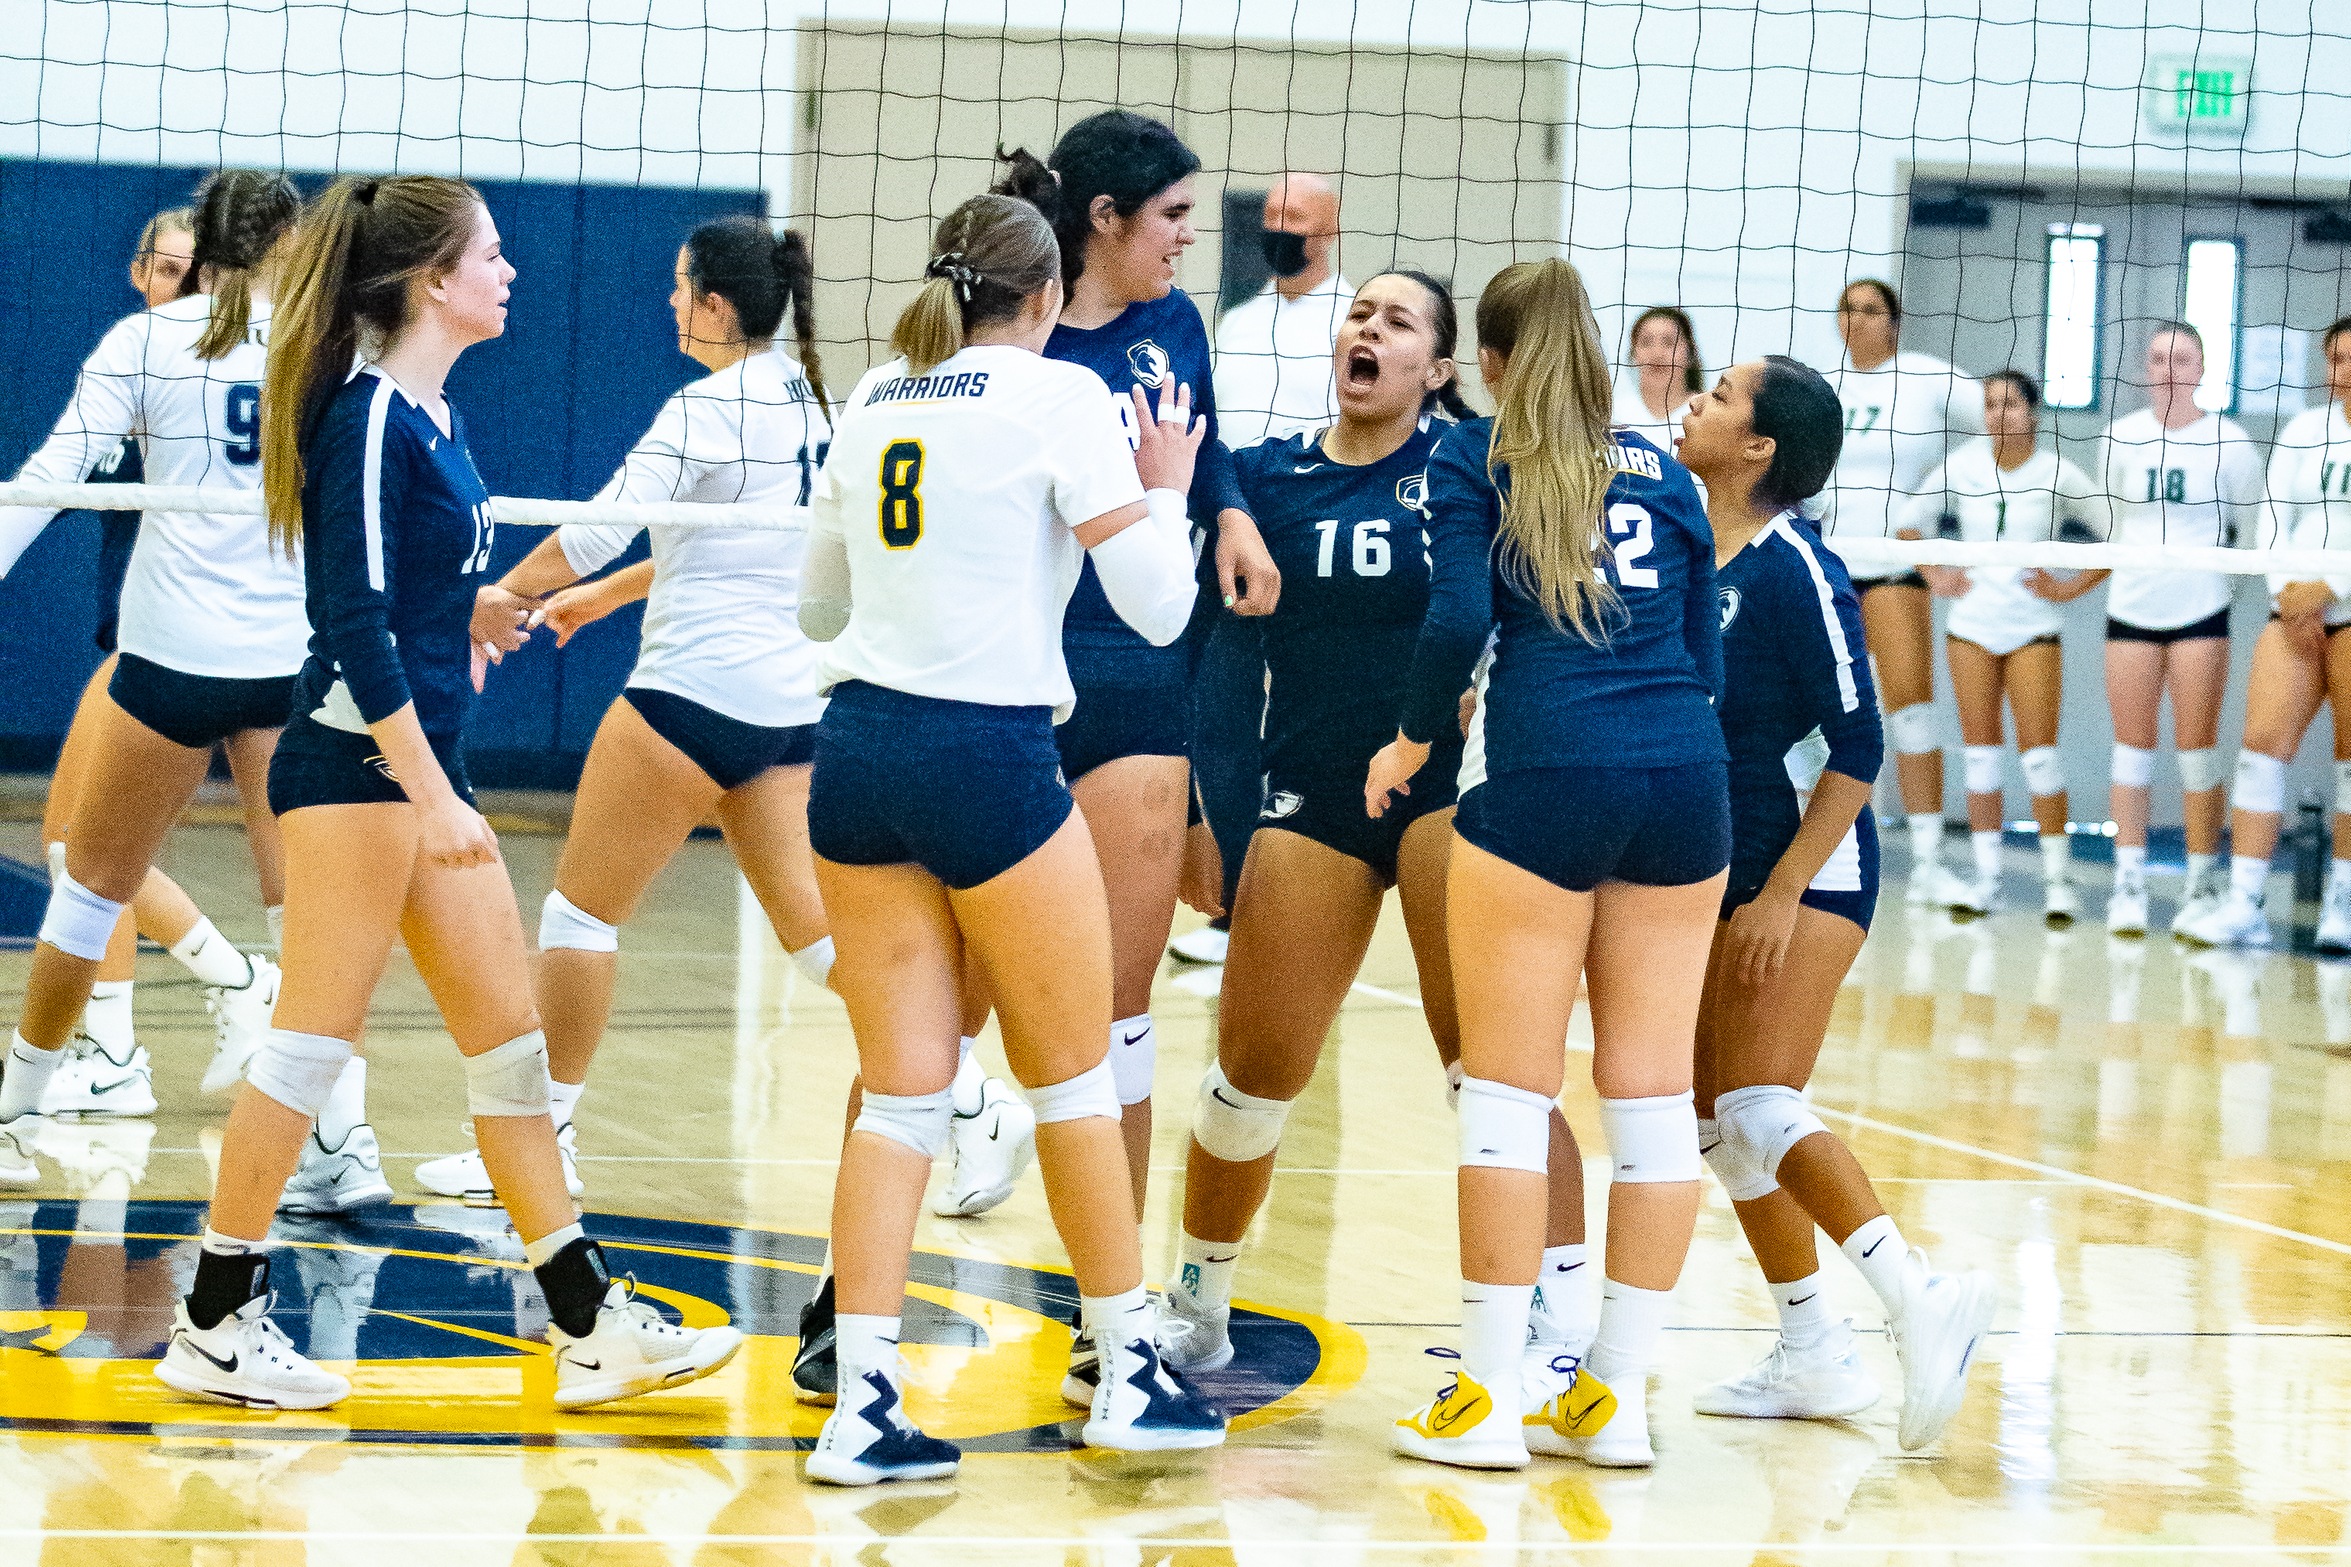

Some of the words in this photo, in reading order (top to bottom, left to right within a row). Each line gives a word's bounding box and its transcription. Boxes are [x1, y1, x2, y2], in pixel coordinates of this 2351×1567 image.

[2177, 71, 2234, 117] EXIT
[864, 372, 989, 407] WARRIORS
[878, 438, 926, 551] 8
[2146, 467, 2186, 503] 18
[1315, 519, 1391, 577] 16
